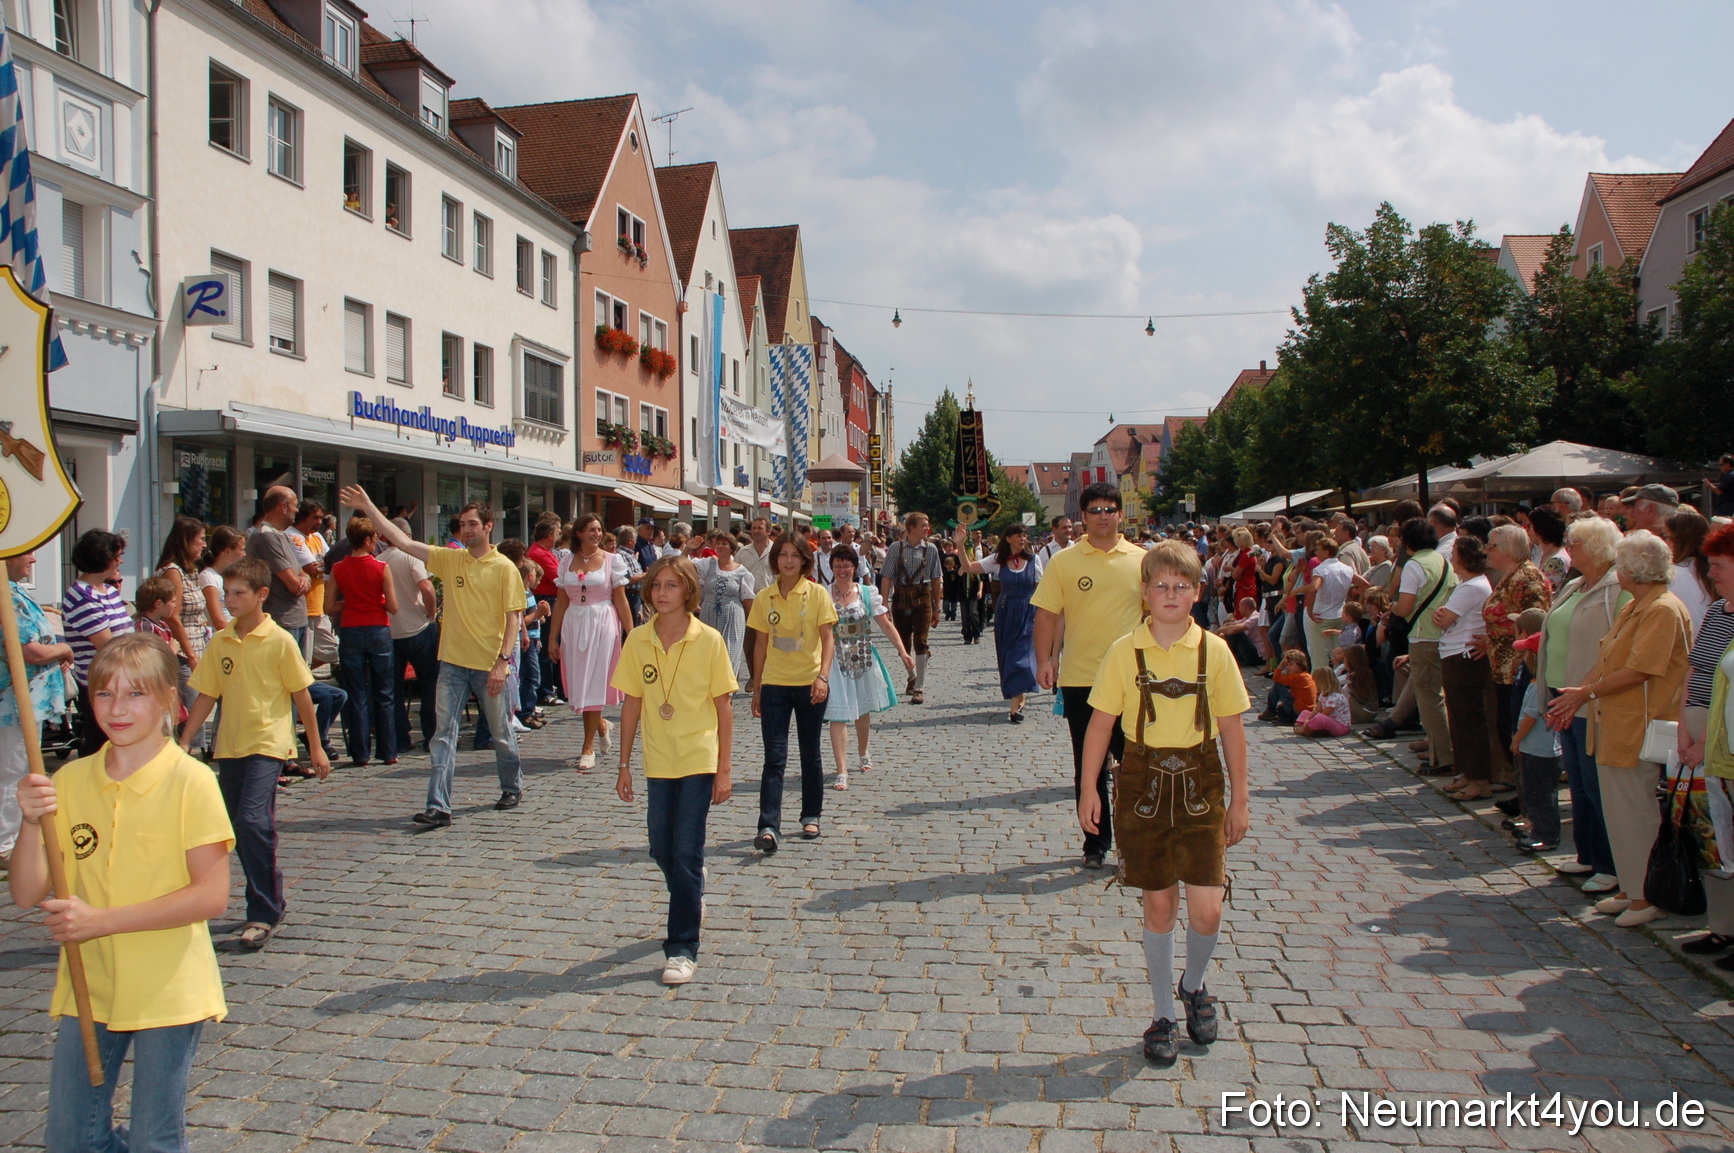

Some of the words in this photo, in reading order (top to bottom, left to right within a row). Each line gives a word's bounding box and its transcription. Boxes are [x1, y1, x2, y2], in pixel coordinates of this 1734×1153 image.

[352, 391, 456, 442] Buchhandlung
[460, 415, 516, 448] Rupprecht
[191, 454, 227, 470] Rupprecht
[308, 468, 335, 482] Rupprecht
[869, 435, 881, 496] HOTEL
